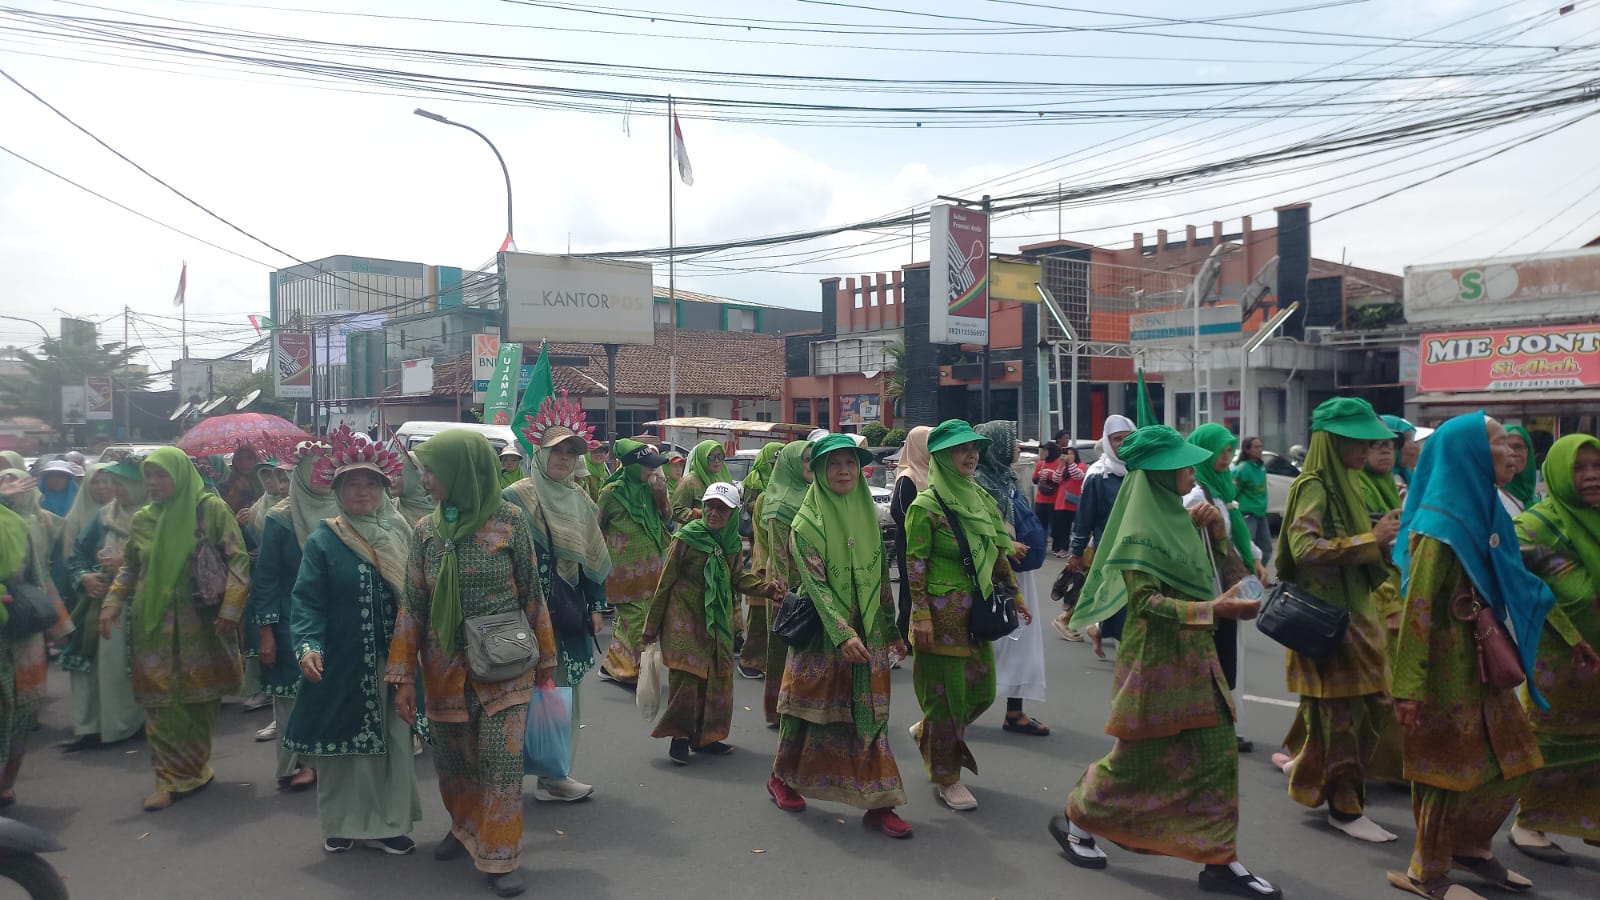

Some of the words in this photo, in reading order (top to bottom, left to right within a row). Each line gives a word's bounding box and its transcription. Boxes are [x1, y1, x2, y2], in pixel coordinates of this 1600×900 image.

[1428, 336, 1493, 364] MIE
[1490, 360, 1515, 378] Si
[1516, 357, 1581, 377] Abah
